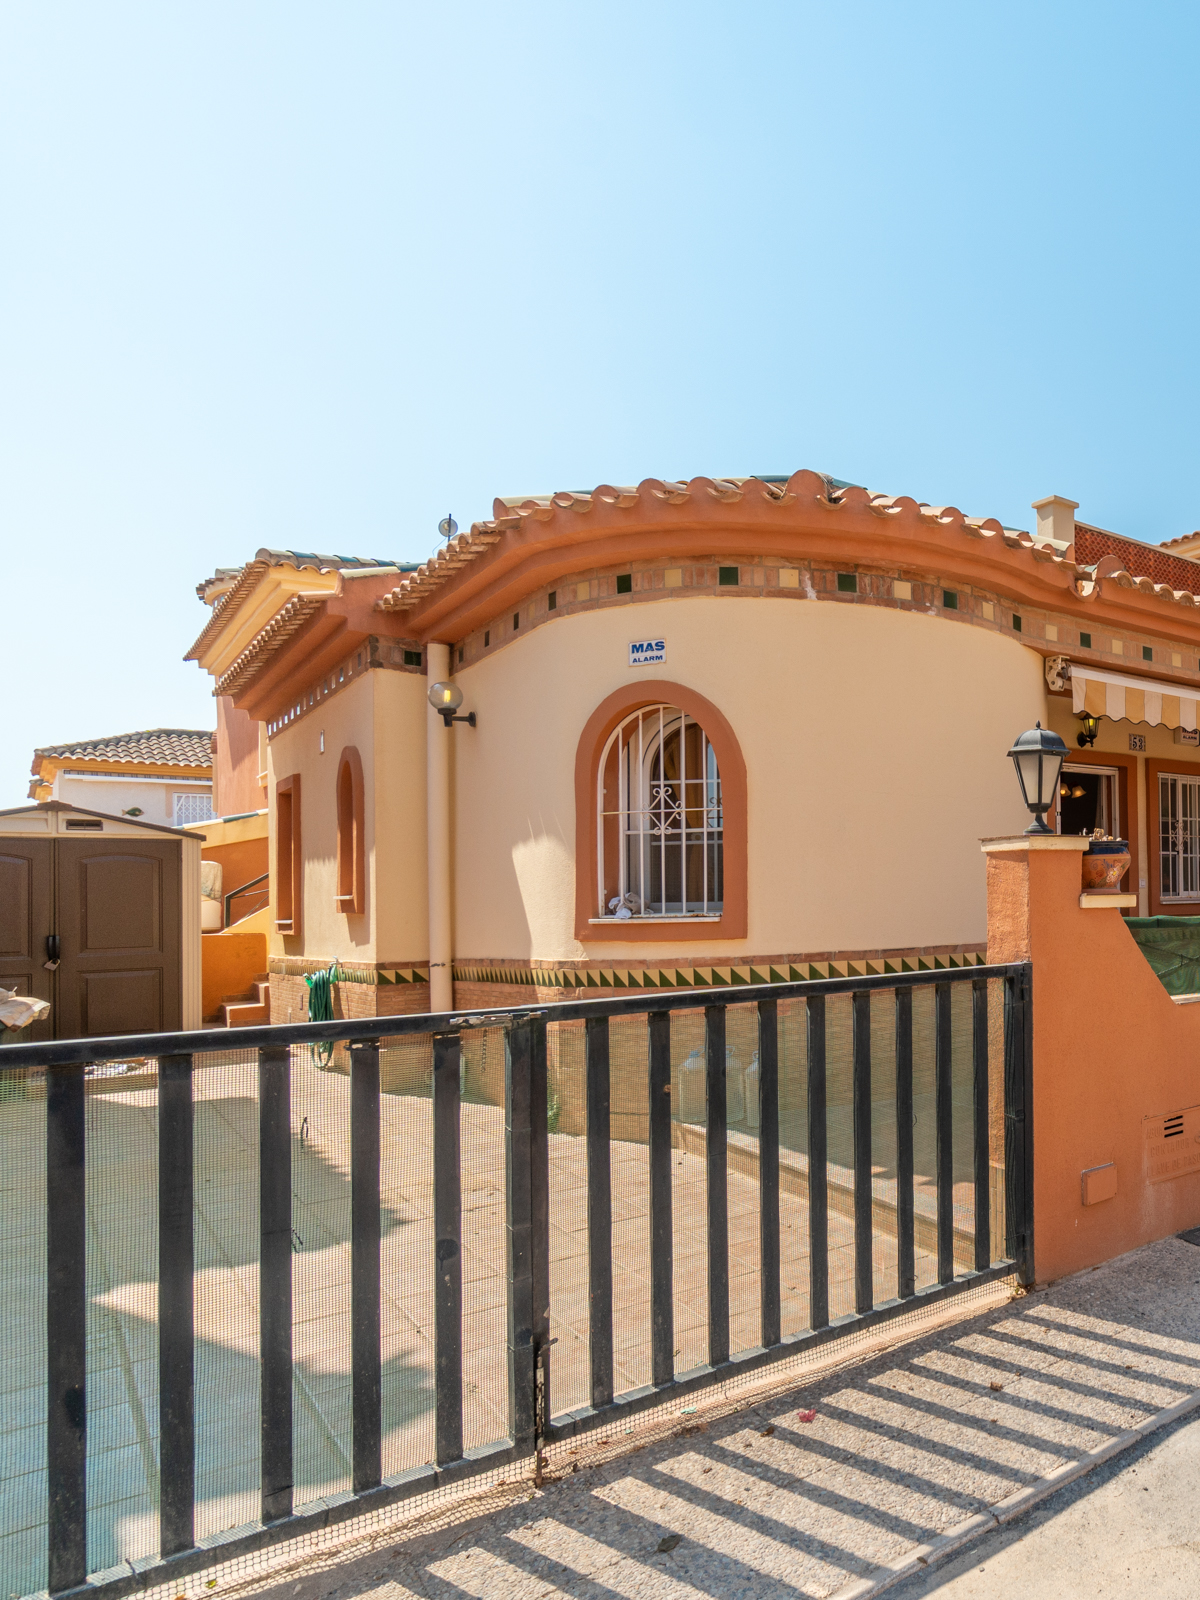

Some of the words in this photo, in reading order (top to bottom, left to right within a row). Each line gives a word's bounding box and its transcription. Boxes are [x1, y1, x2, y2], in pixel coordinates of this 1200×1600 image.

[631, 641, 665, 654] MAS
[632, 655, 663, 663] ALARM
[1132, 737, 1143, 749] 53
[1184, 1152, 1200, 1168] PASO
